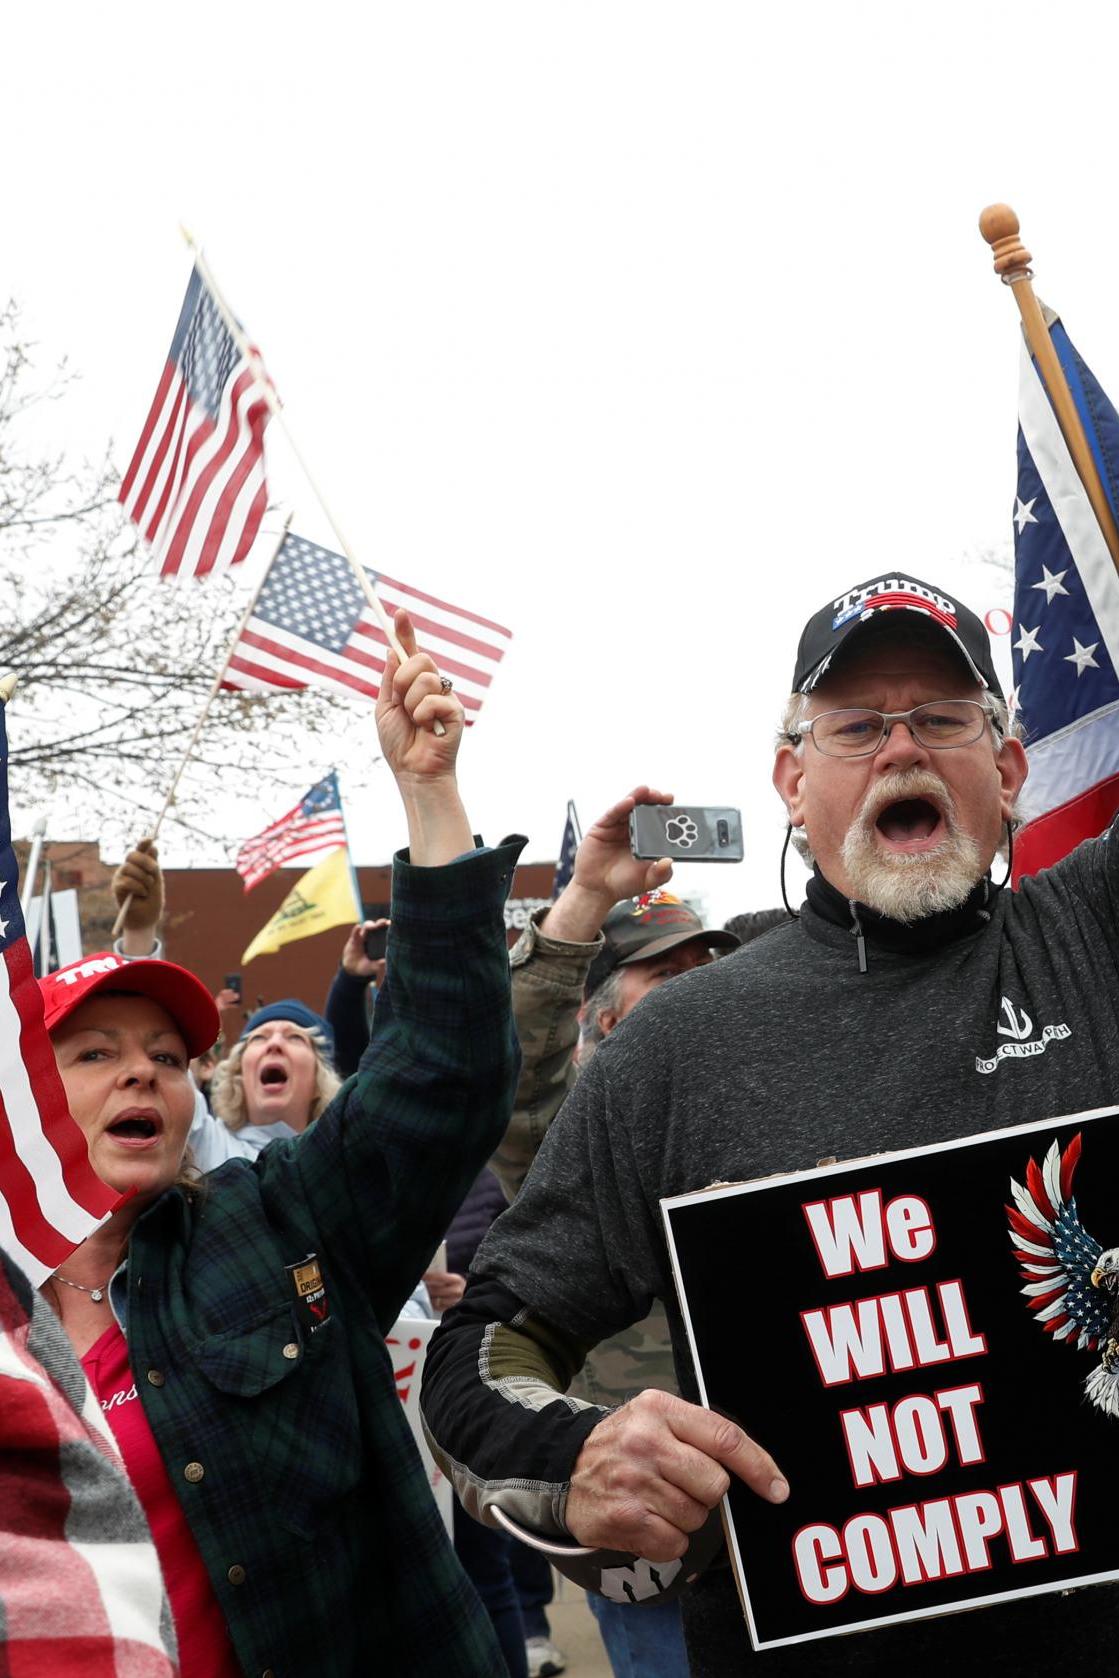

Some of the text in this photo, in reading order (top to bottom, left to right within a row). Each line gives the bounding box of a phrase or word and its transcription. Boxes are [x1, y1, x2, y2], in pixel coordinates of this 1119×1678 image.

[833, 578, 957, 618] Trump
[802, 1188, 935, 1279] We
[800, 1279, 988, 1387] WILL
[840, 1383, 985, 1488] NOT
[792, 1470, 1079, 1605] COMPLY
